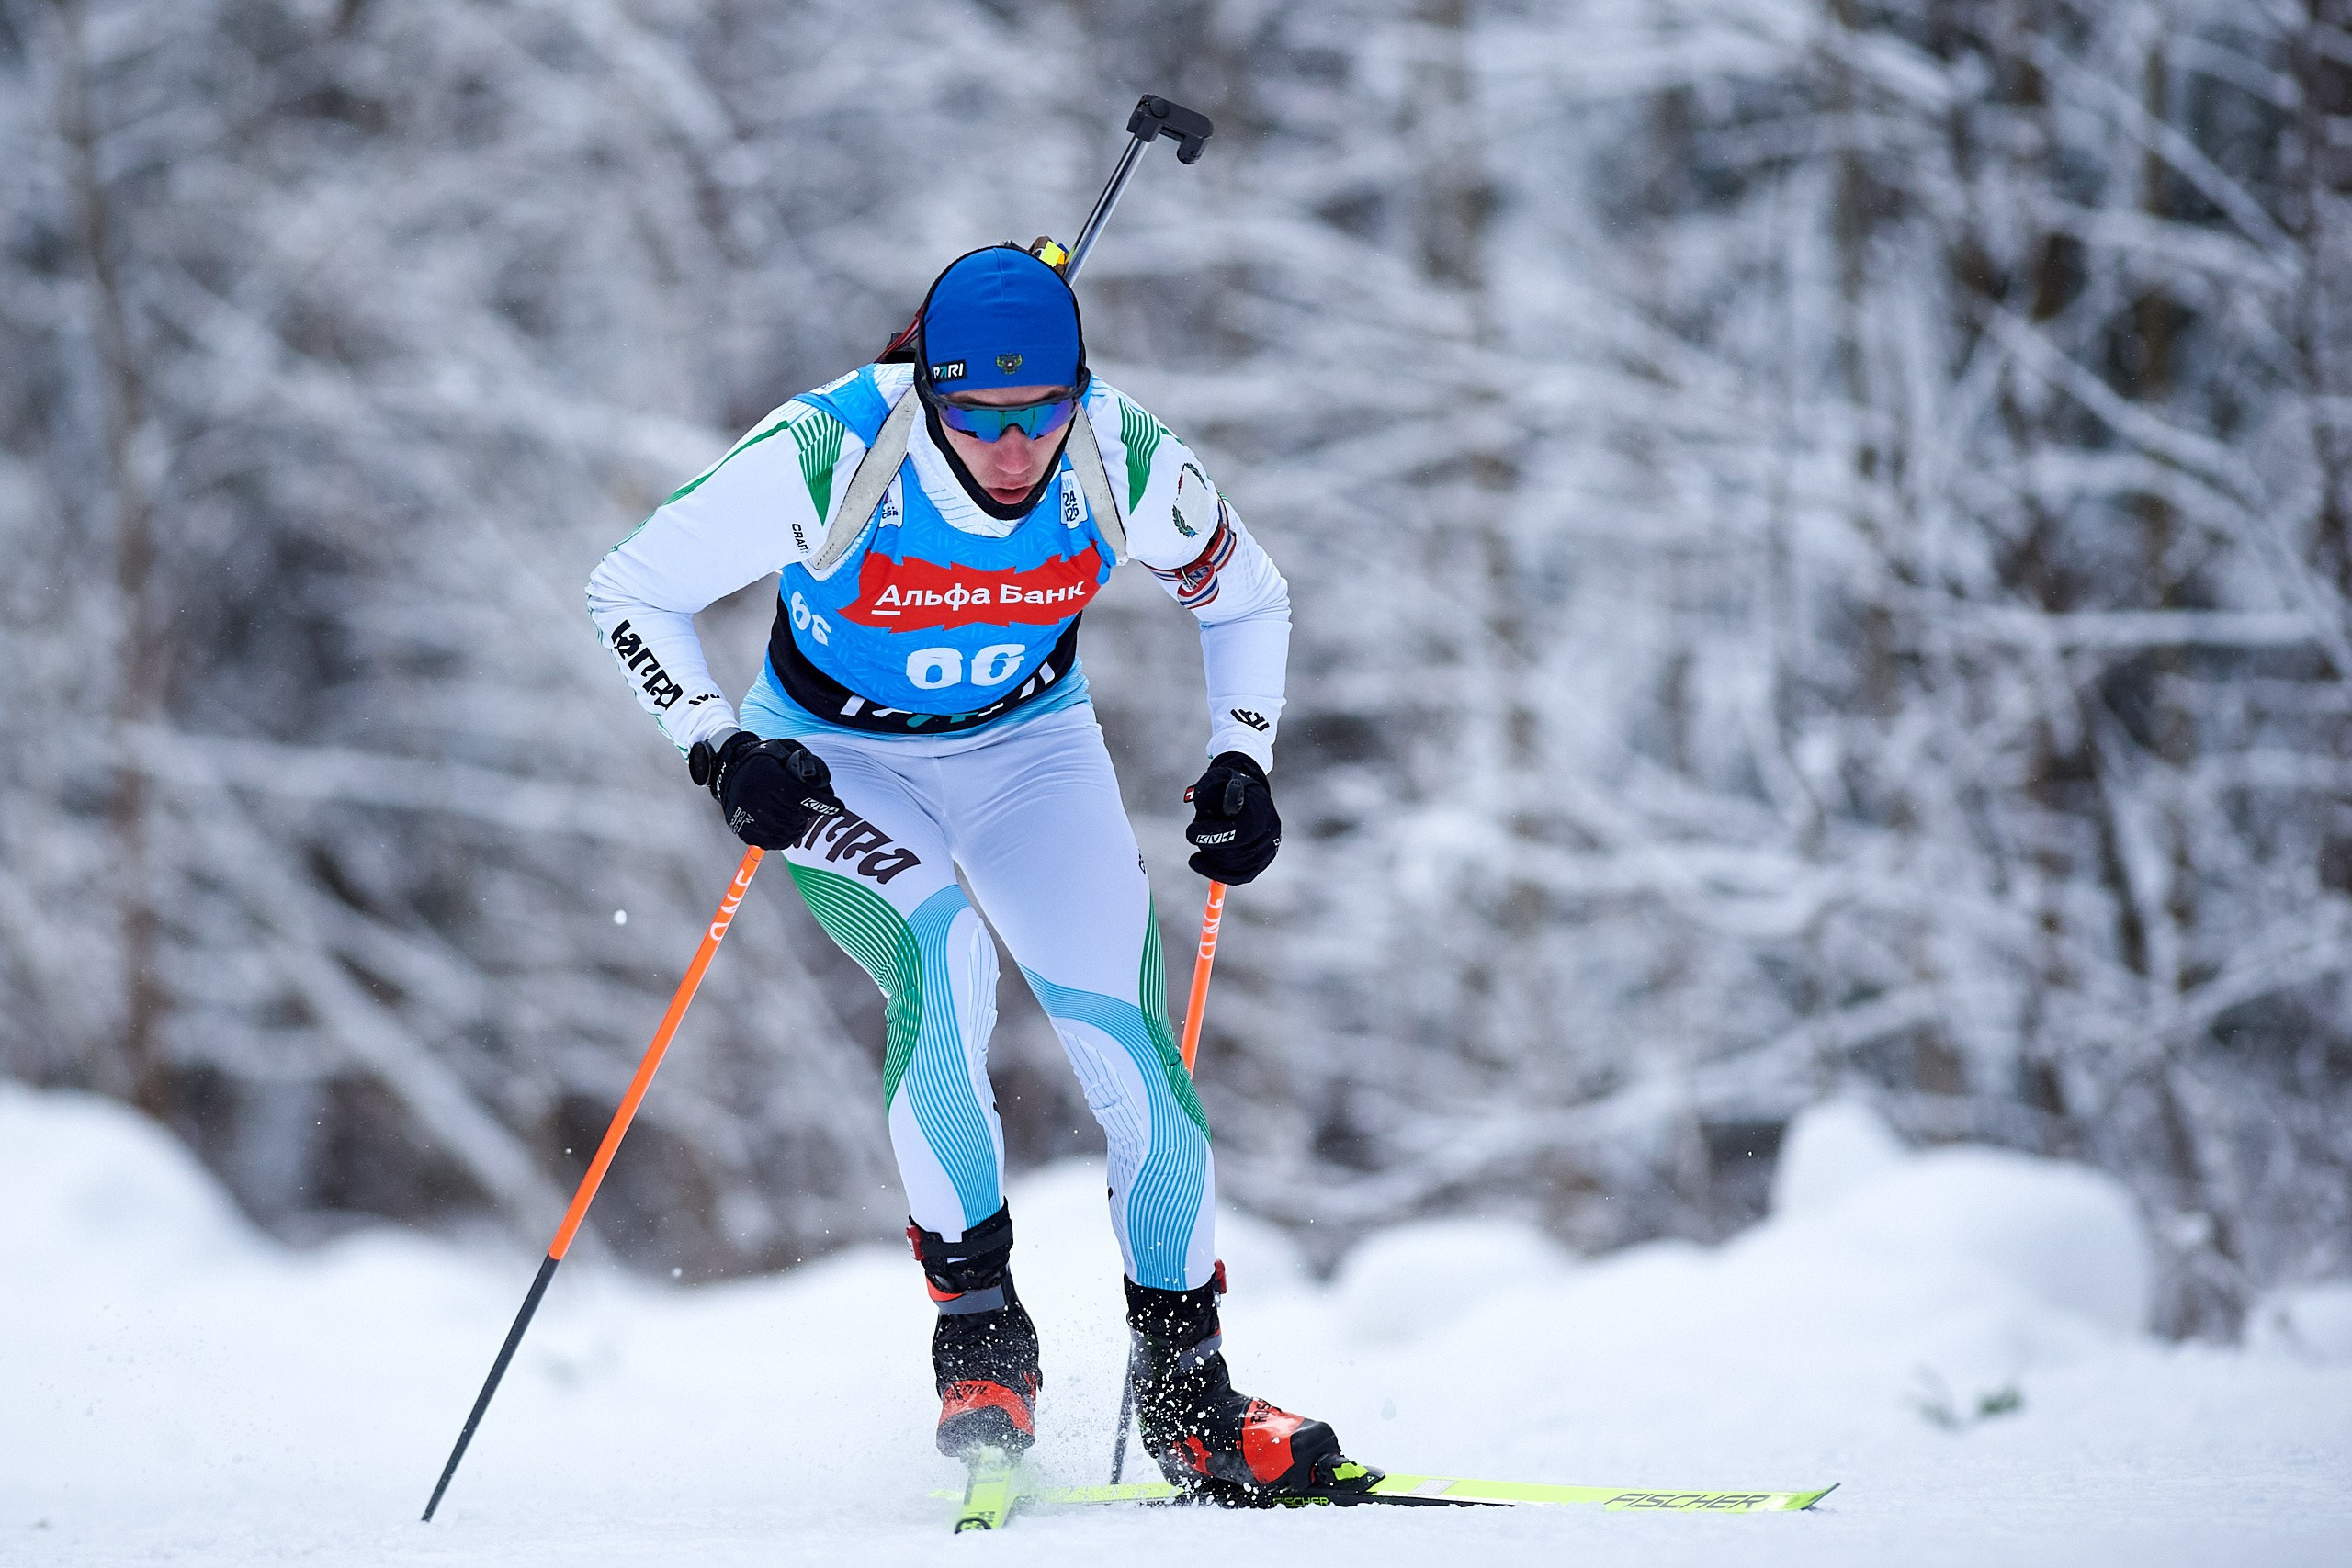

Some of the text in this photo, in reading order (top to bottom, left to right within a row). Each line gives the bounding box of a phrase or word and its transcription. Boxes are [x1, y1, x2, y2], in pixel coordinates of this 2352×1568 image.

[933, 363, 964, 379] PARI
[1063, 490, 1077, 507] 24
[874, 581, 1086, 611] Альфа Банк
[1604, 1493, 1770, 1509] FISCHER
